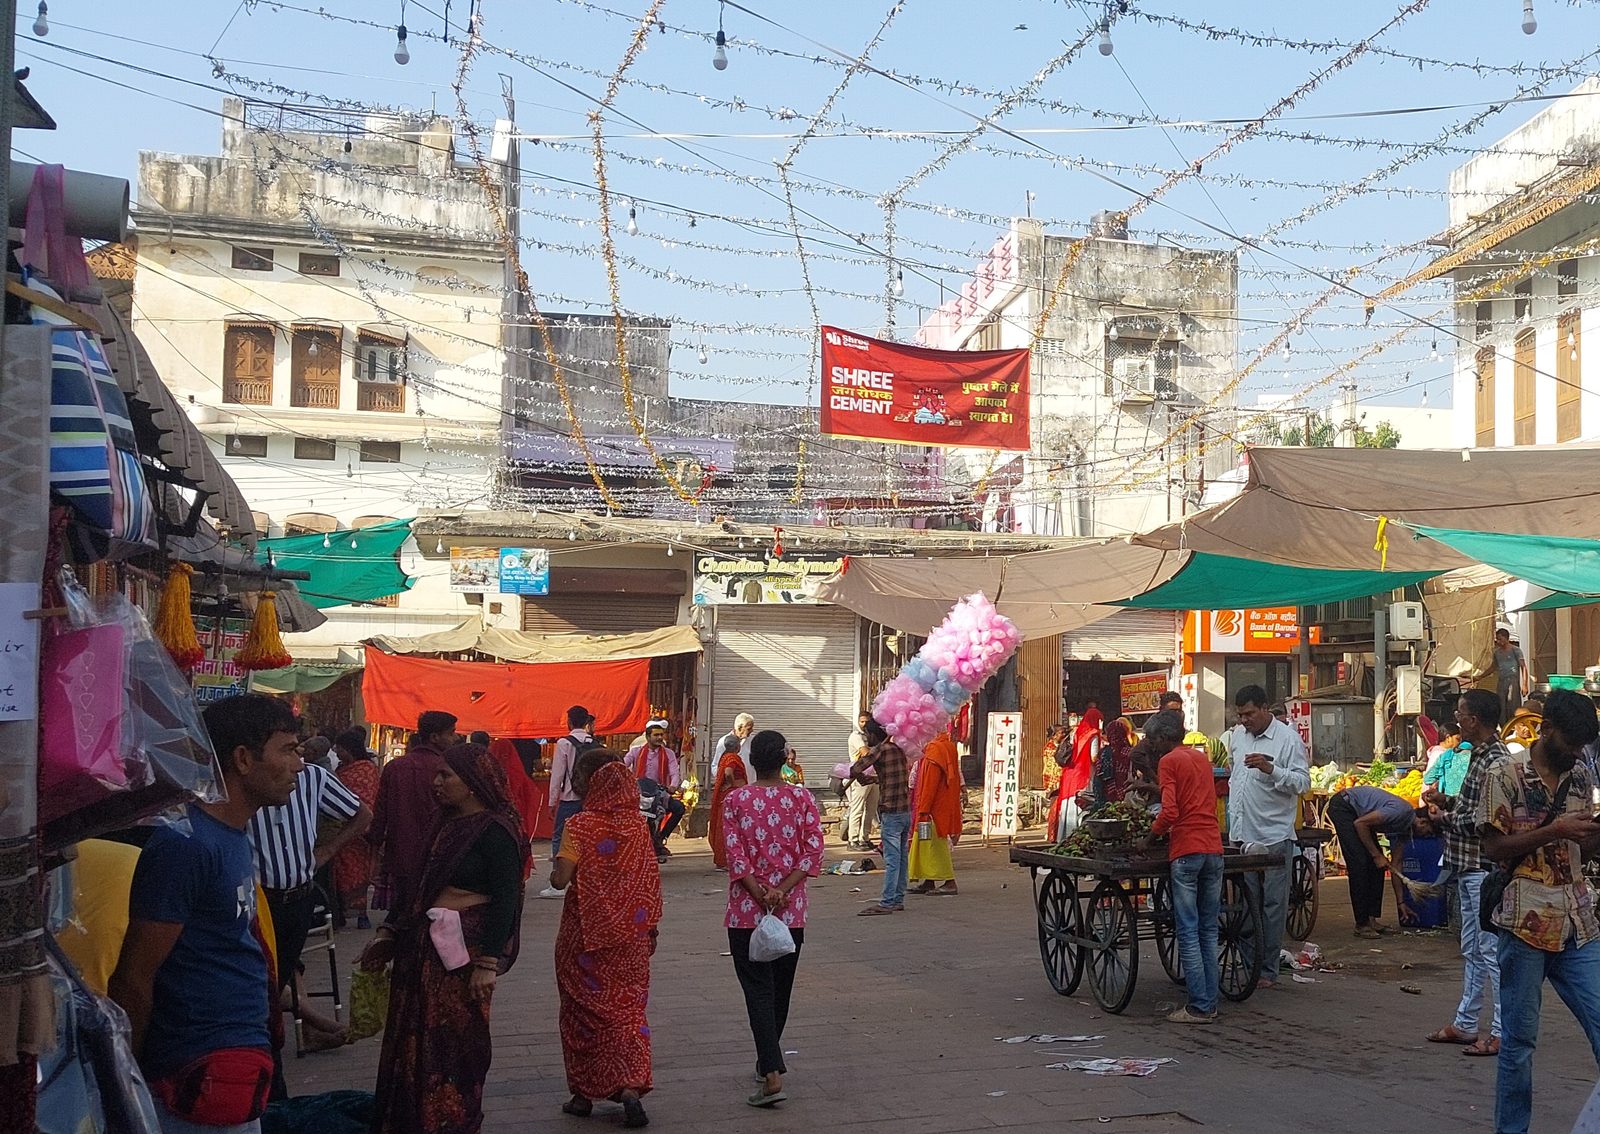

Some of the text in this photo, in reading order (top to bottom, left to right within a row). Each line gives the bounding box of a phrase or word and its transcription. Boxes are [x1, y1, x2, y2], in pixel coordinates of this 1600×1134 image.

[831, 366, 894, 390] SHREE
[831, 385, 855, 396] जंग
[830, 395, 893, 414] CEMENT
[975, 397, 1007, 408] आपका
[698, 557, 843, 575] Chandan Readymad
[1250, 623, 1266, 631] Bank
[1267, 623, 1274, 631] of
[1005, 733, 1017, 830] PHARMACY
